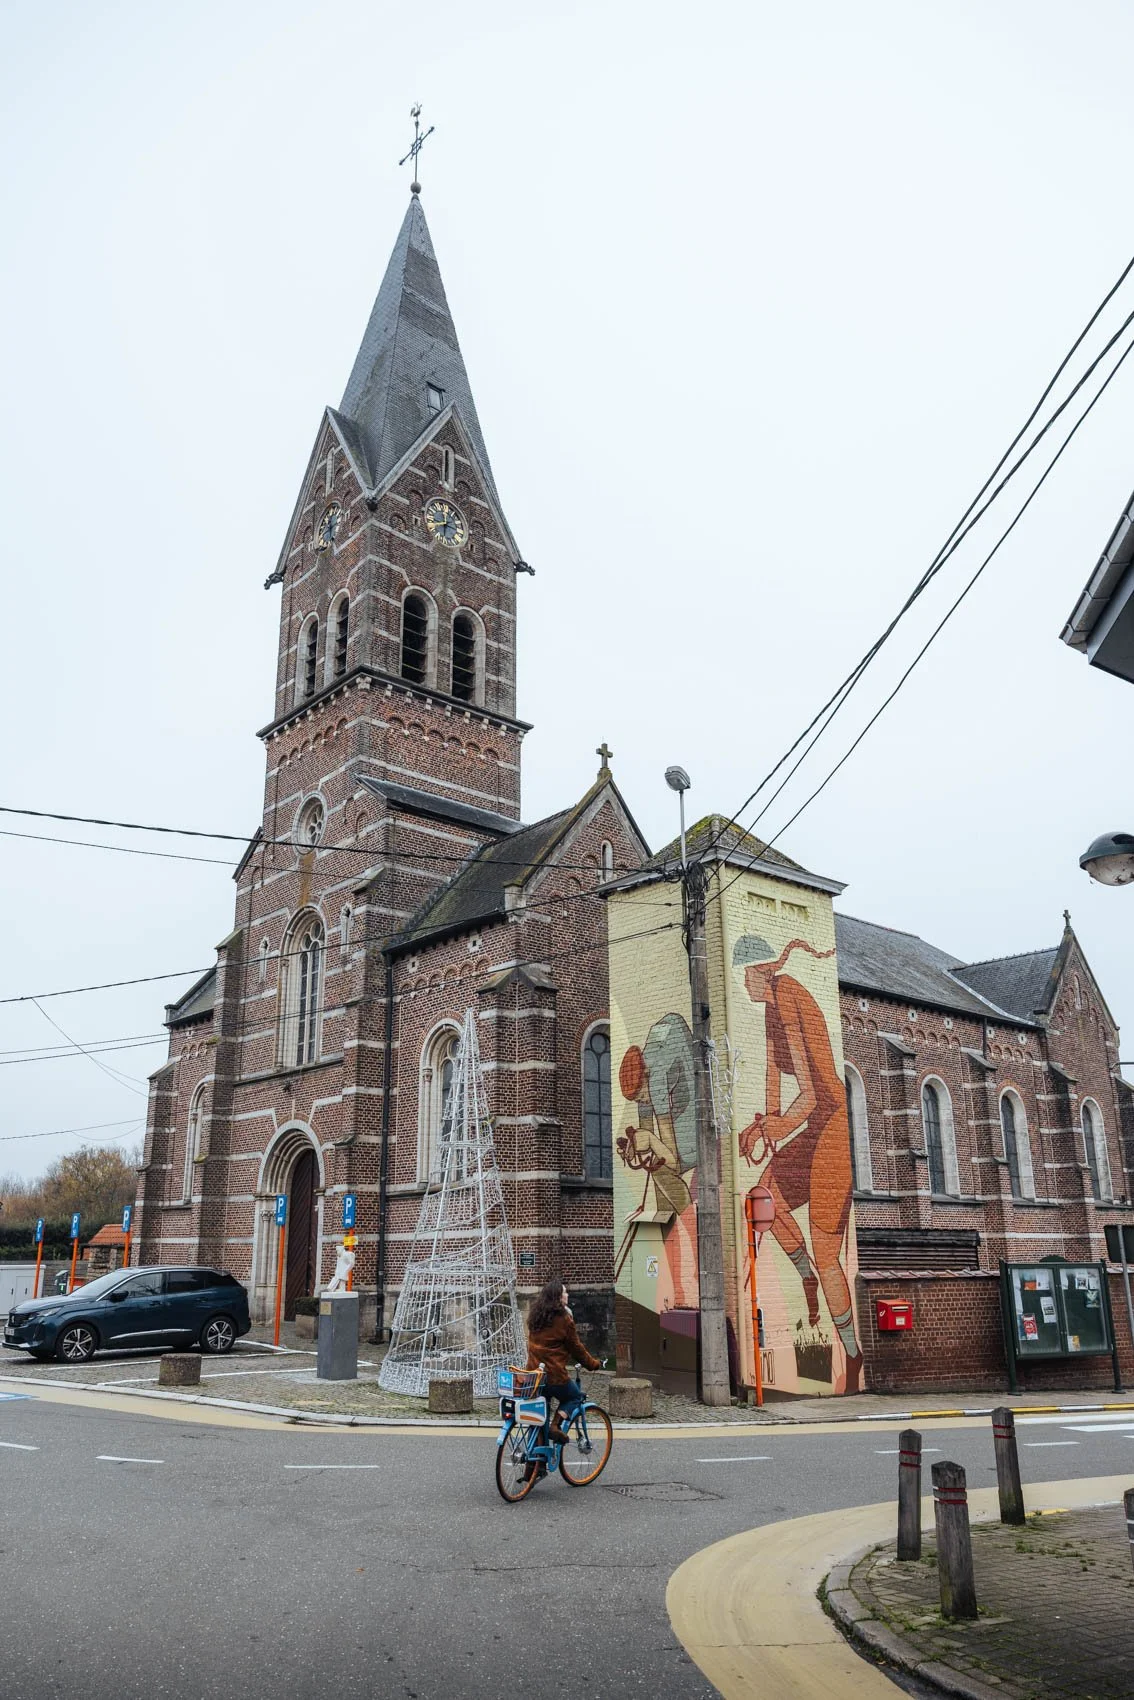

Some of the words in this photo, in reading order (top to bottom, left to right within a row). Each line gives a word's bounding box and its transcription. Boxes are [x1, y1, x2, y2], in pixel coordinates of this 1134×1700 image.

[277, 1197, 284, 1213] P
[345, 1197, 352, 1214] P
[72, 1215, 78, 1227] P
[122, 1210, 129, 1228] P
